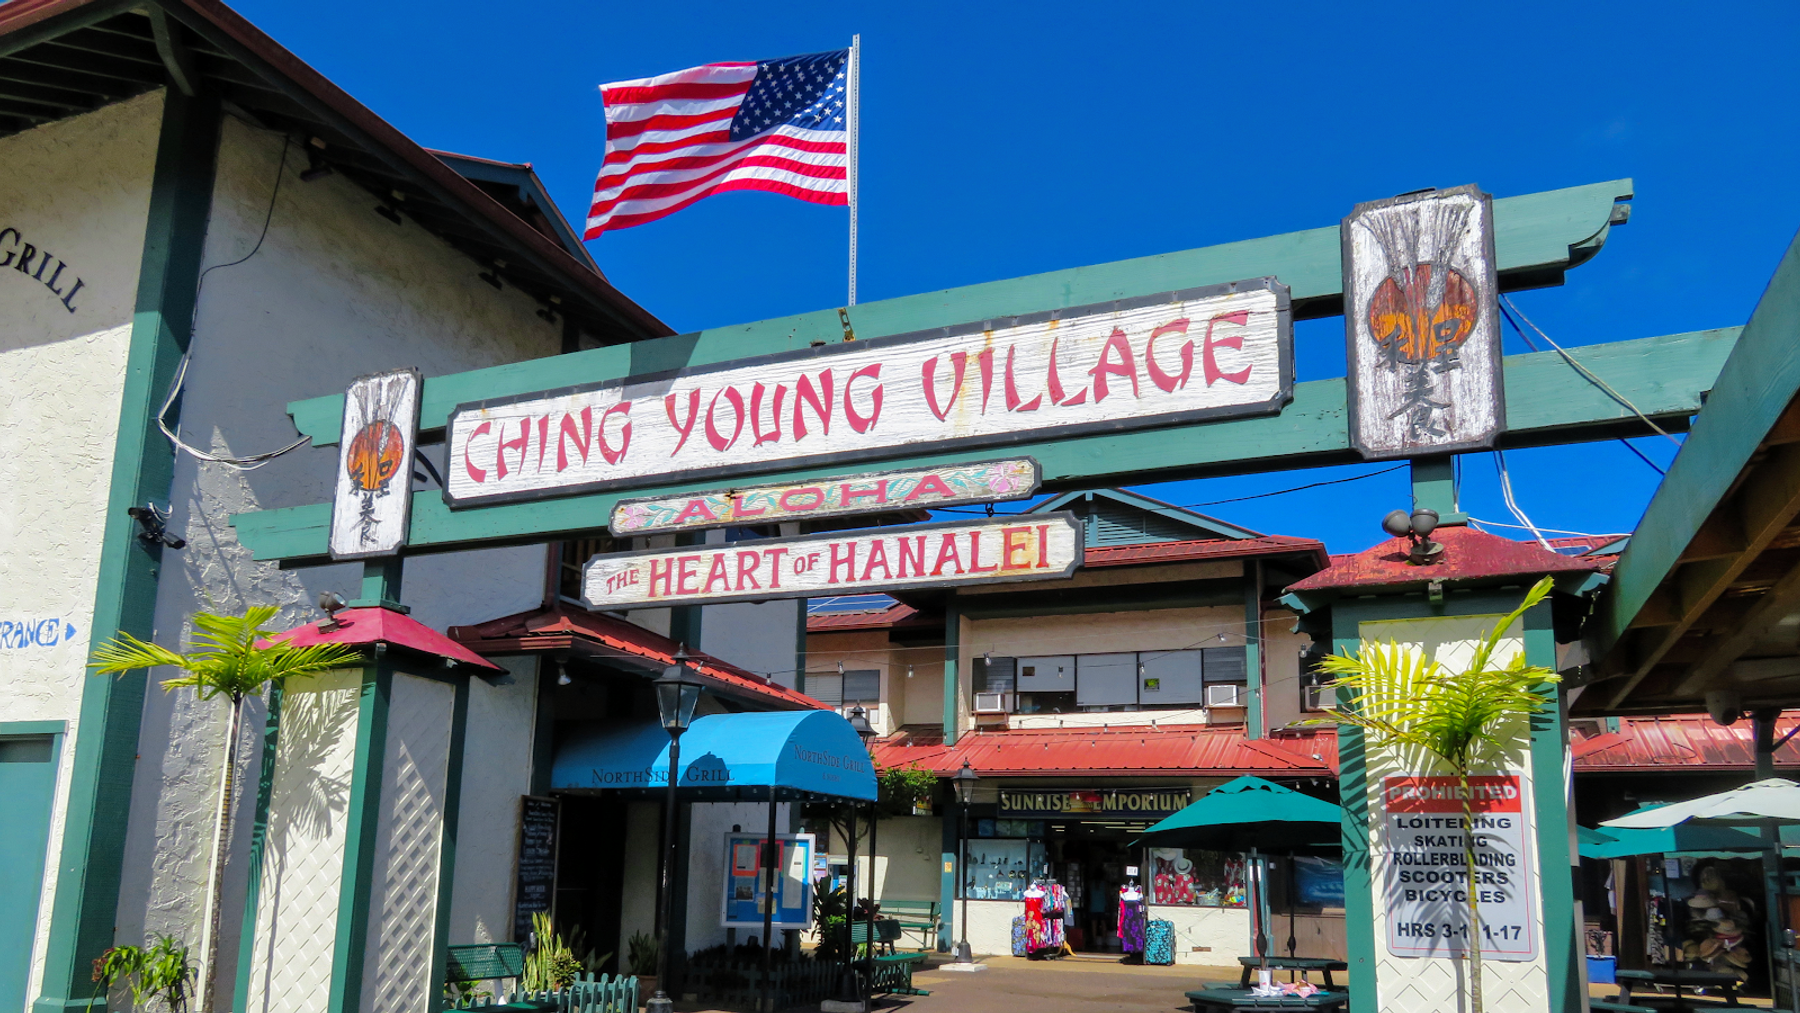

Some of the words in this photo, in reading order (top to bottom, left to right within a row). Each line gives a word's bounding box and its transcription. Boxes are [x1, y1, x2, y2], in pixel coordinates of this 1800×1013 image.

[0, 228, 85, 313] GRILL
[465, 401, 633, 483] CHING
[664, 363, 883, 458] YOUNG
[922, 310, 1253, 422] VILLAGE
[672, 474, 956, 524] ALOHA
[606, 567, 641, 595] THE
[646, 547, 790, 598] HEART
[793, 552, 820, 576] OF
[828, 524, 1051, 584] HANALEI
[0, 618, 59, 649] RANCE
[843, 755, 865, 773] GRILL
[592, 767, 679, 784] NORTHSID
[686, 766, 735, 782] GRILL
[1389, 785, 1517, 800] PROHIBITED
[1001, 793, 1071, 811] SUNRISE
[1093, 793, 1188, 811] EMPORIUM
[1405, 889, 1506, 904] BICYCES
[1397, 922, 1436, 938] HRS
